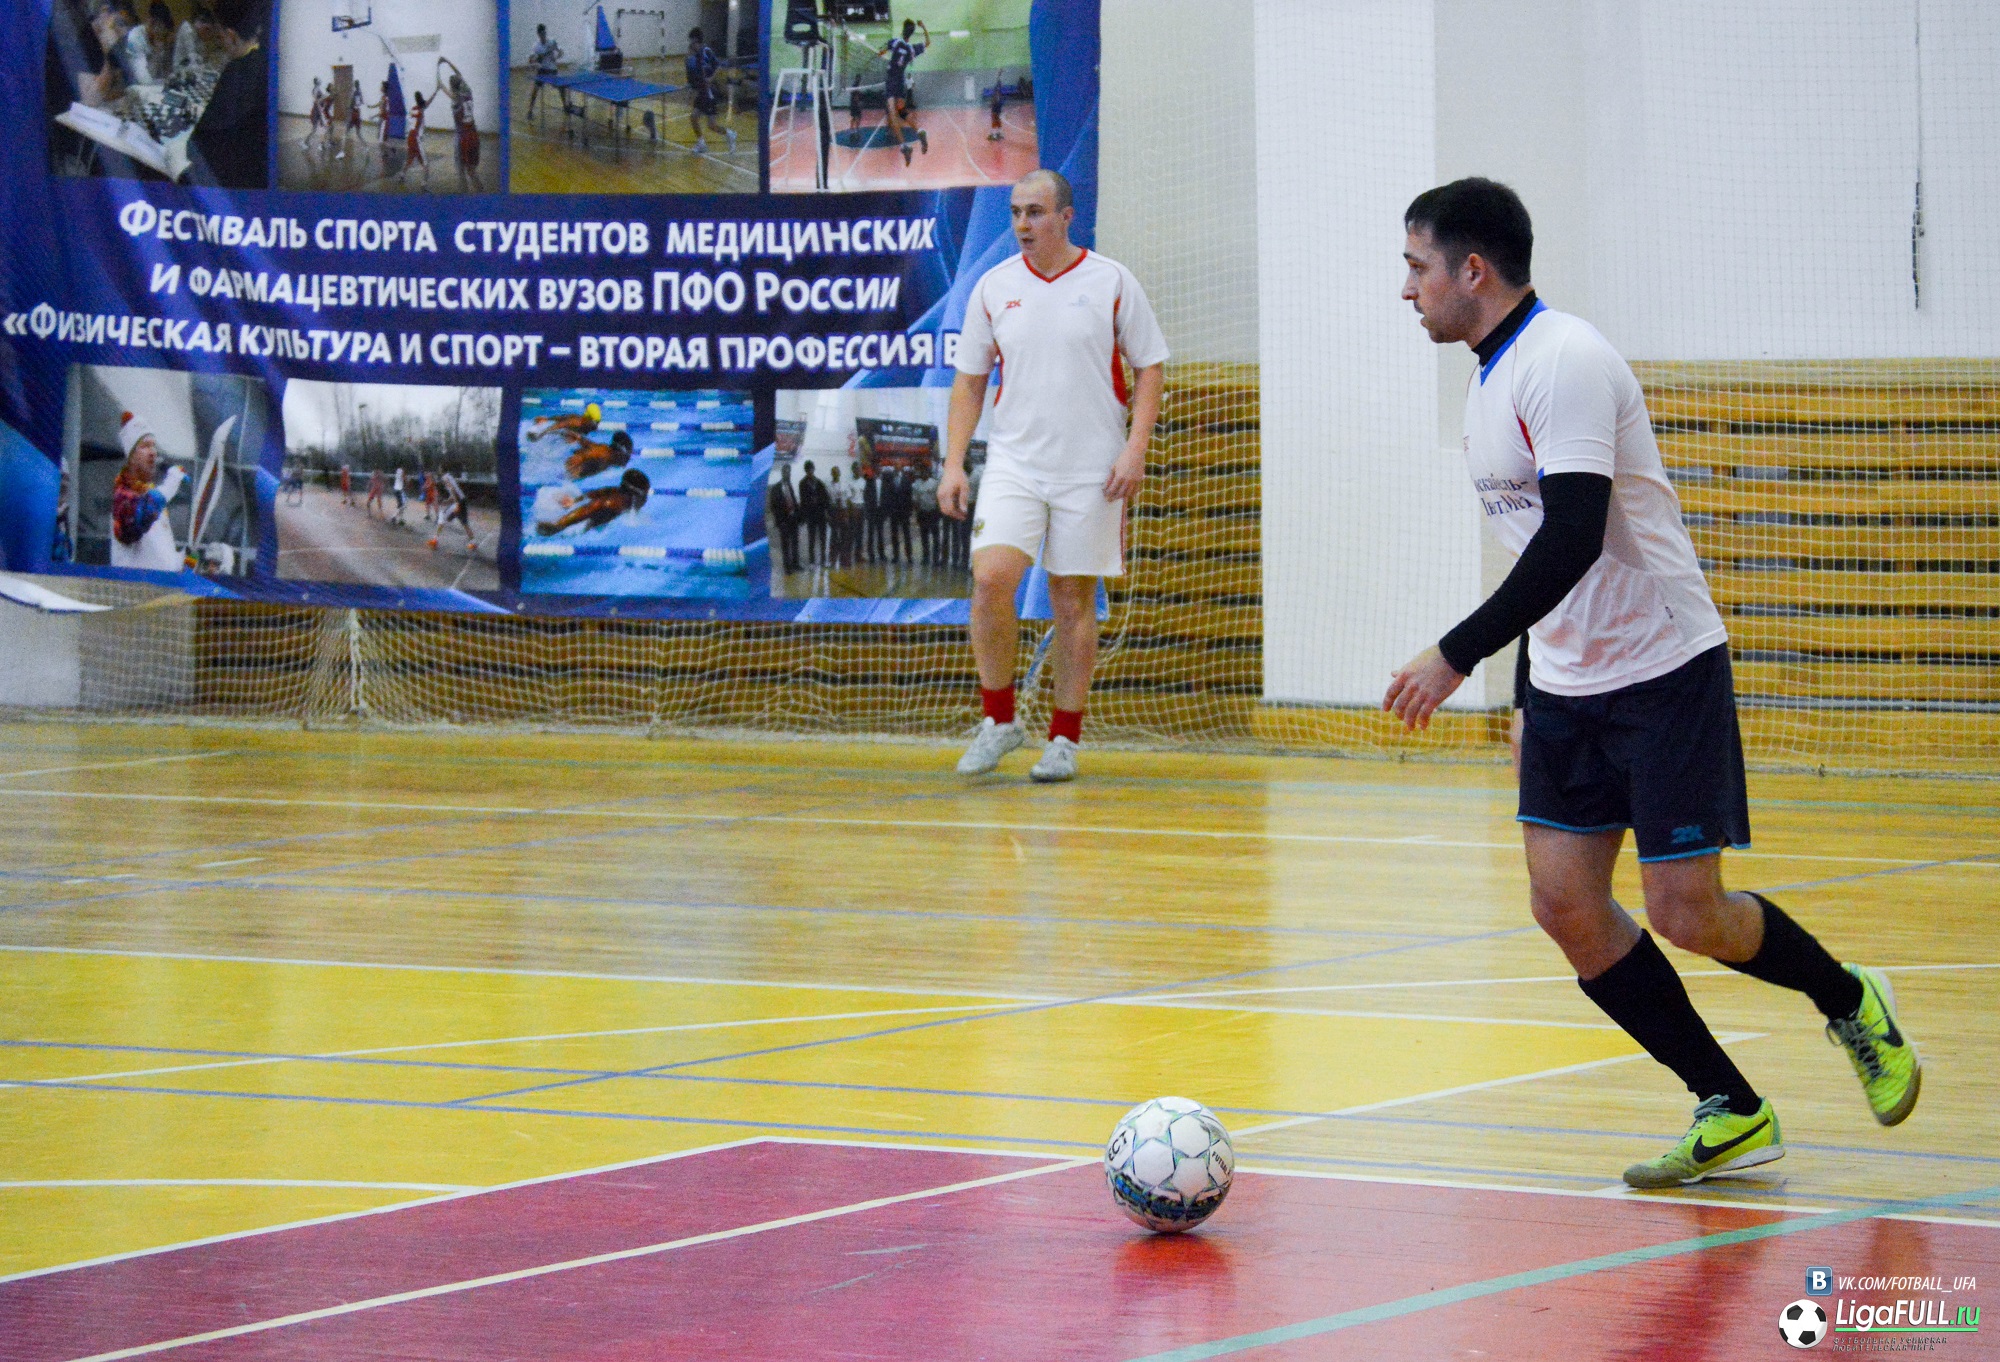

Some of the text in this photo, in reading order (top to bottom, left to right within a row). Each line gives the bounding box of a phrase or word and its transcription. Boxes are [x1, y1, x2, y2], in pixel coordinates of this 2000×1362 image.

[315, 219, 437, 252] СПОРТА
[454, 221, 649, 261] СТУДЕНТОВ
[666, 217, 936, 262] МЕДИЦИНСКИХ
[150, 263, 901, 313] И ФАРМАЦЕВТИЧЕСКИХ ВУЗОВ ПФО РОССИИ
[3, 302, 232, 353] «ФИЗИЧЕСКАЯ
[239, 324, 392, 361] КУЛЬТУРА
[400, 333, 422, 364] И
[430, 333, 543, 366] СПОРТ
[580, 336, 708, 368] ВТОРАЯ
[719, 333, 933, 369] ПРОФЕССИЯ
